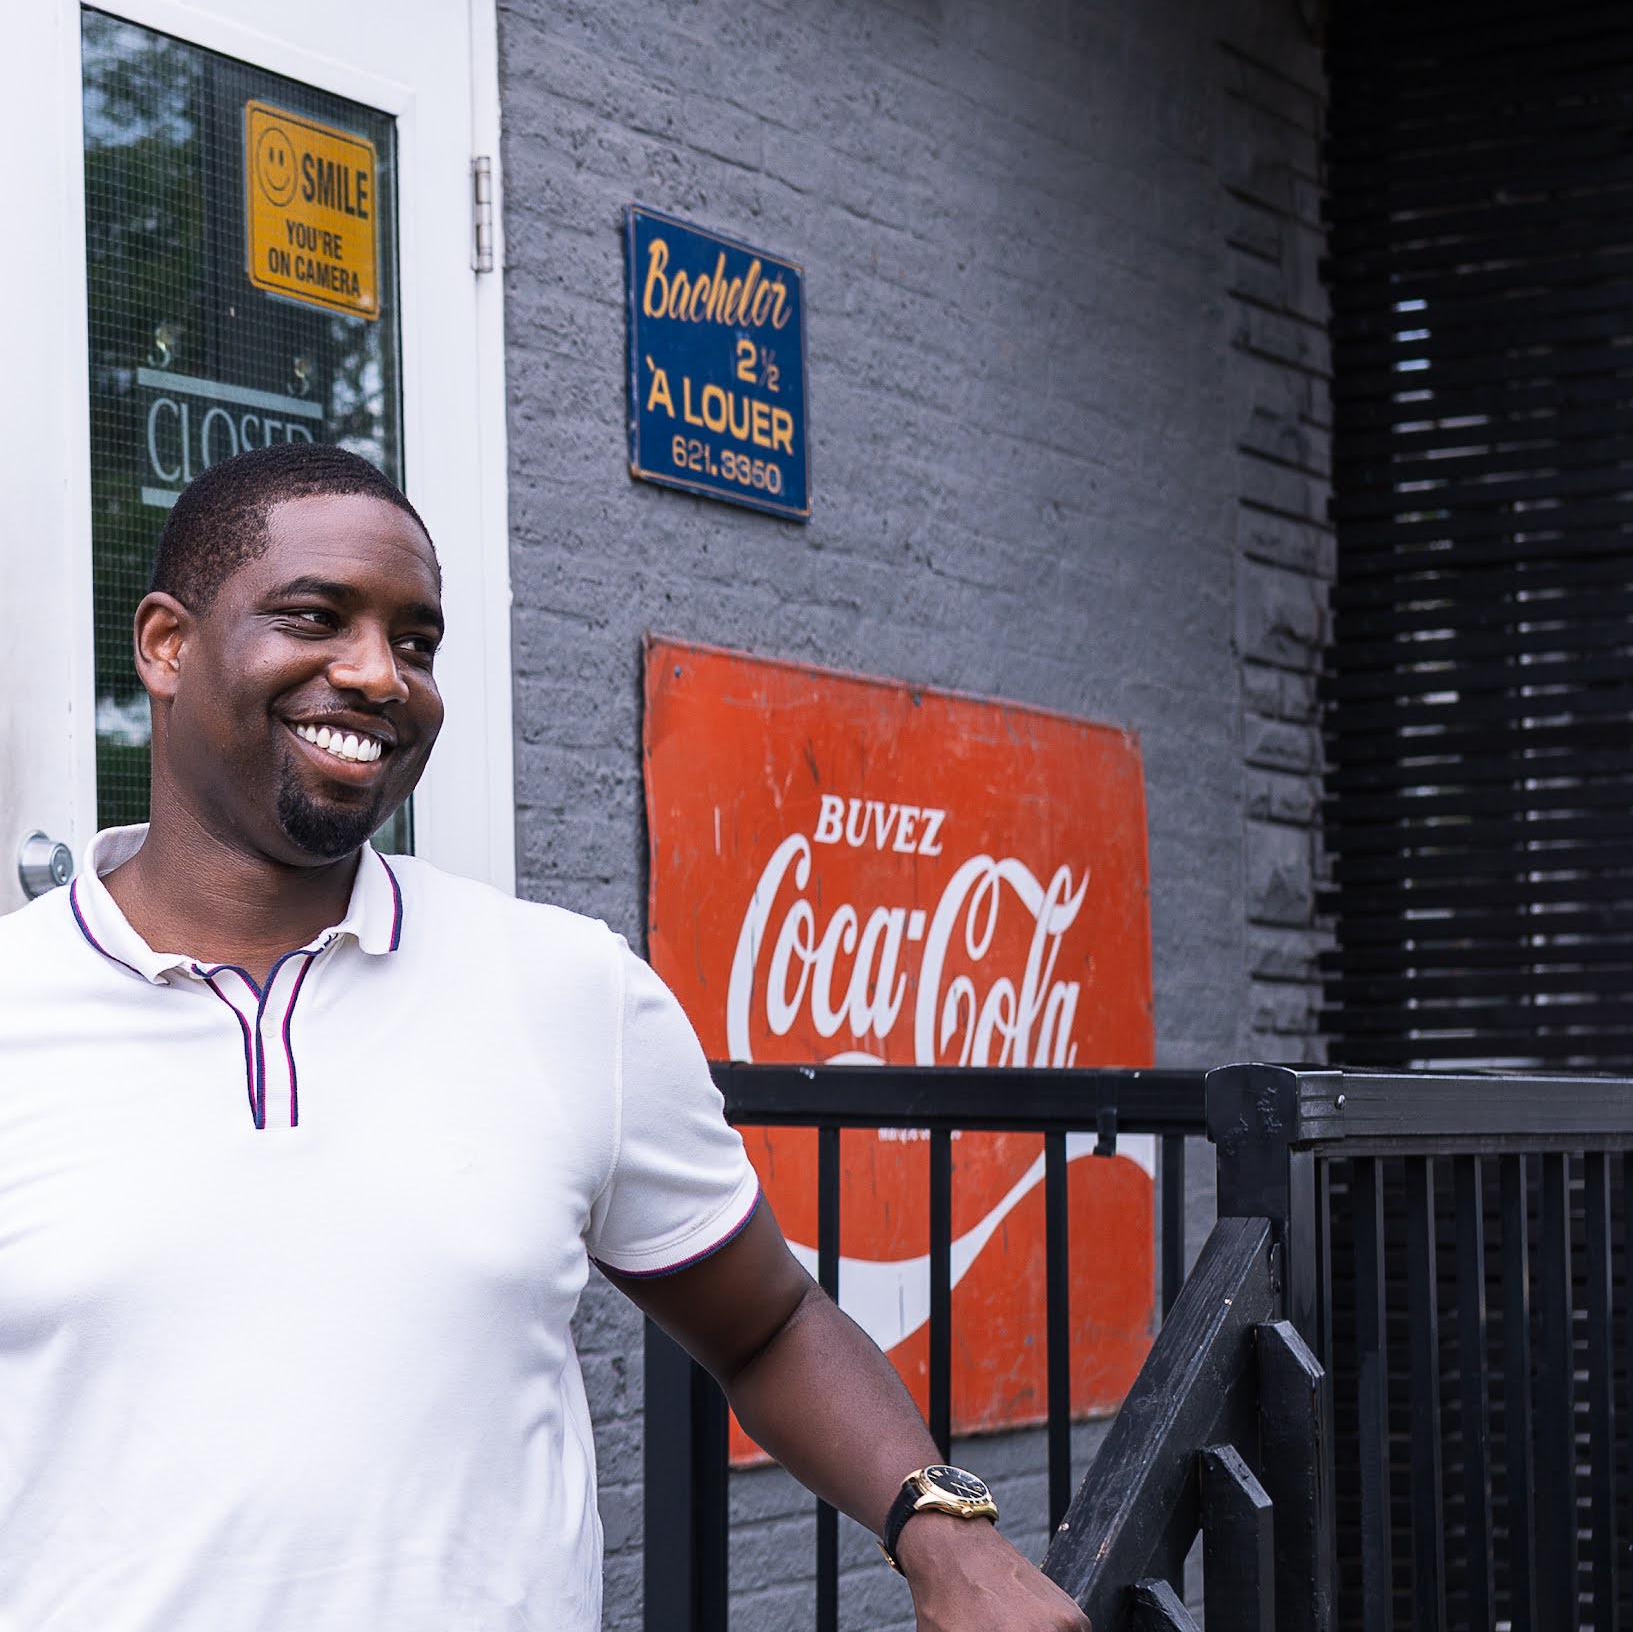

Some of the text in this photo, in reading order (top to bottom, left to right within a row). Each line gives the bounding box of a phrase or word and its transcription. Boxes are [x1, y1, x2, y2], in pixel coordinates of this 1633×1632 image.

[301, 152, 369, 221] SMILE
[268, 247, 361, 299] ON CAMERA
[285, 218, 344, 261] YOU'RE
[642, 237, 793, 331] Bachelor
[682, 375, 795, 457] LOUER
[813, 793, 945, 857] BUVEZ
[726, 832, 1091, 1069] Coca-Cola
